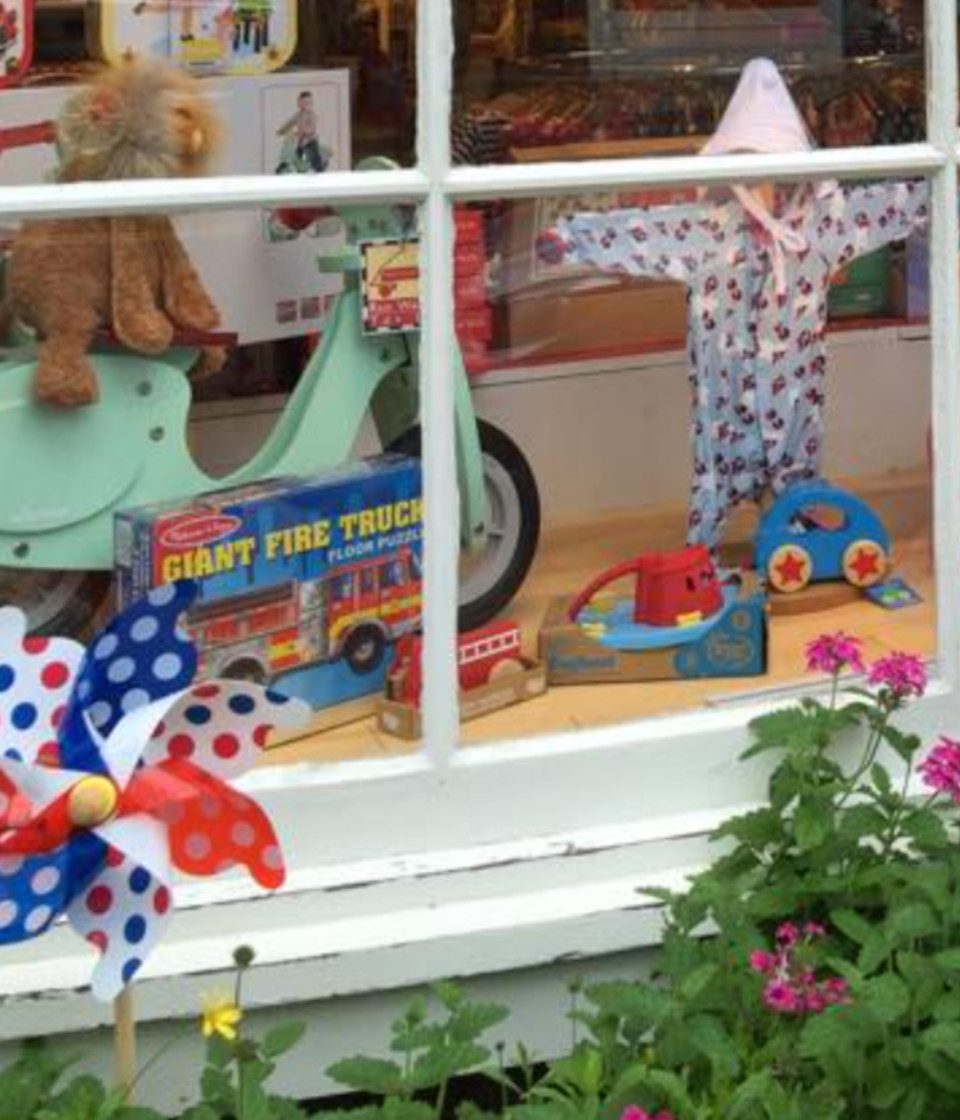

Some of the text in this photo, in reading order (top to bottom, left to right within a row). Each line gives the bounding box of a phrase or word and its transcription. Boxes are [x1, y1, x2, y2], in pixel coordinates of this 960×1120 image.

[162, 536, 255, 582] GIANT
[265, 519, 330, 561] FIRE
[328, 528, 423, 565] FLOOR PUZZL
